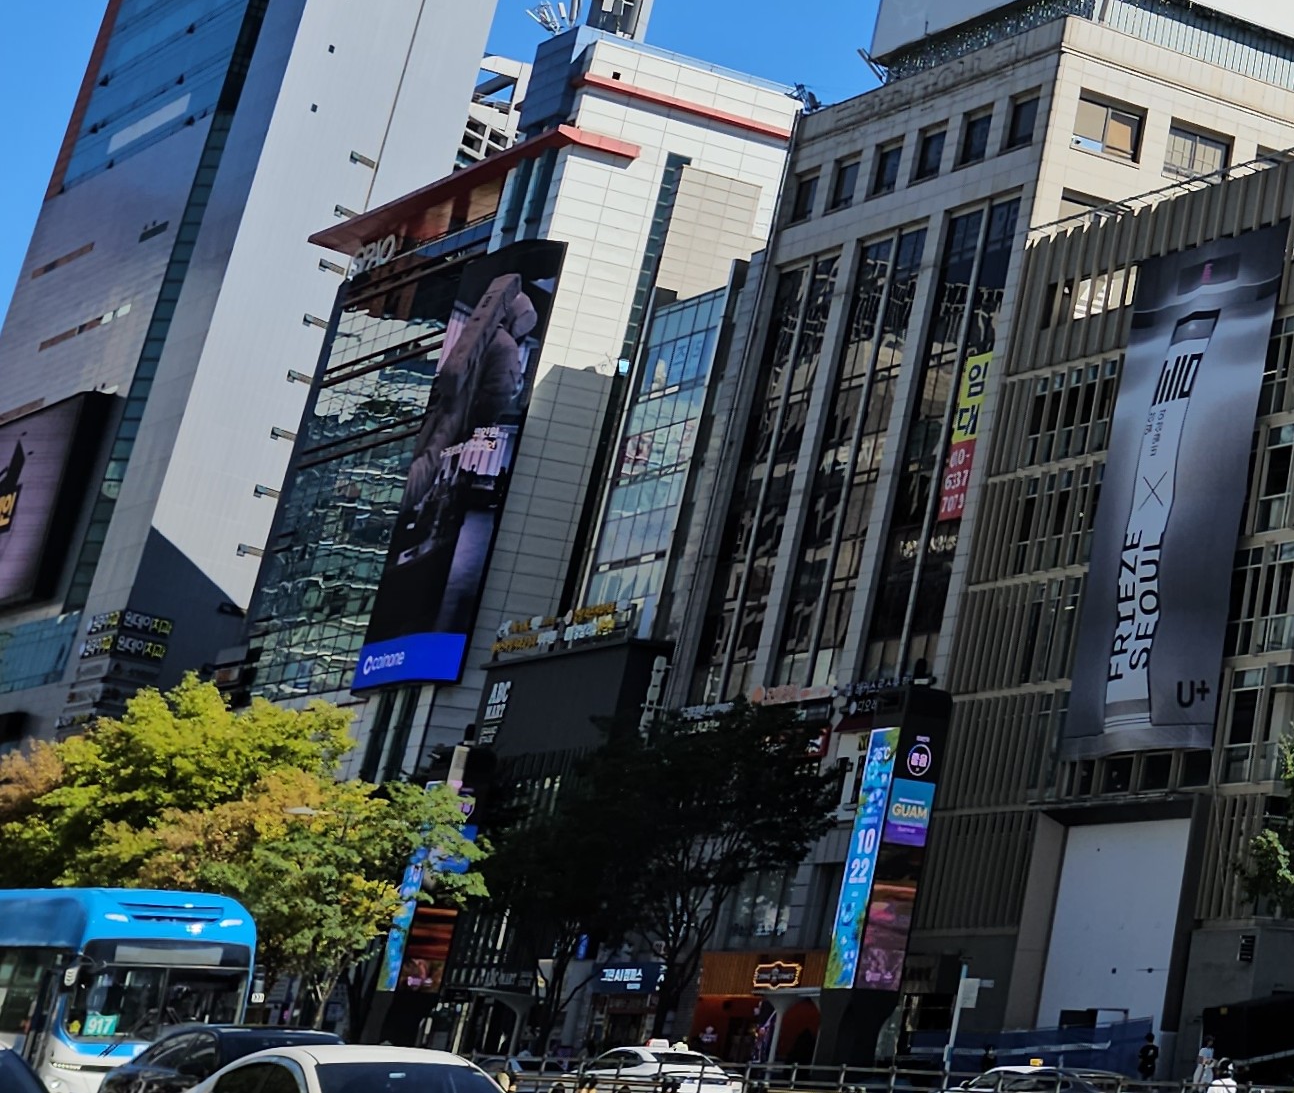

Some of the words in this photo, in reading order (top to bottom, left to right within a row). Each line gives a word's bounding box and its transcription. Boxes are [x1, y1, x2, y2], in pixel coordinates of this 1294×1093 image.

[1107, 529, 1143, 682] FRIEZE
[1129, 532, 1164, 670] SEOUL
[892, 802, 928, 819] GUAM
[857, 828, 876, 855] 10
[849, 857, 871, 884] 22
[87, 1017, 114, 1035] 917
